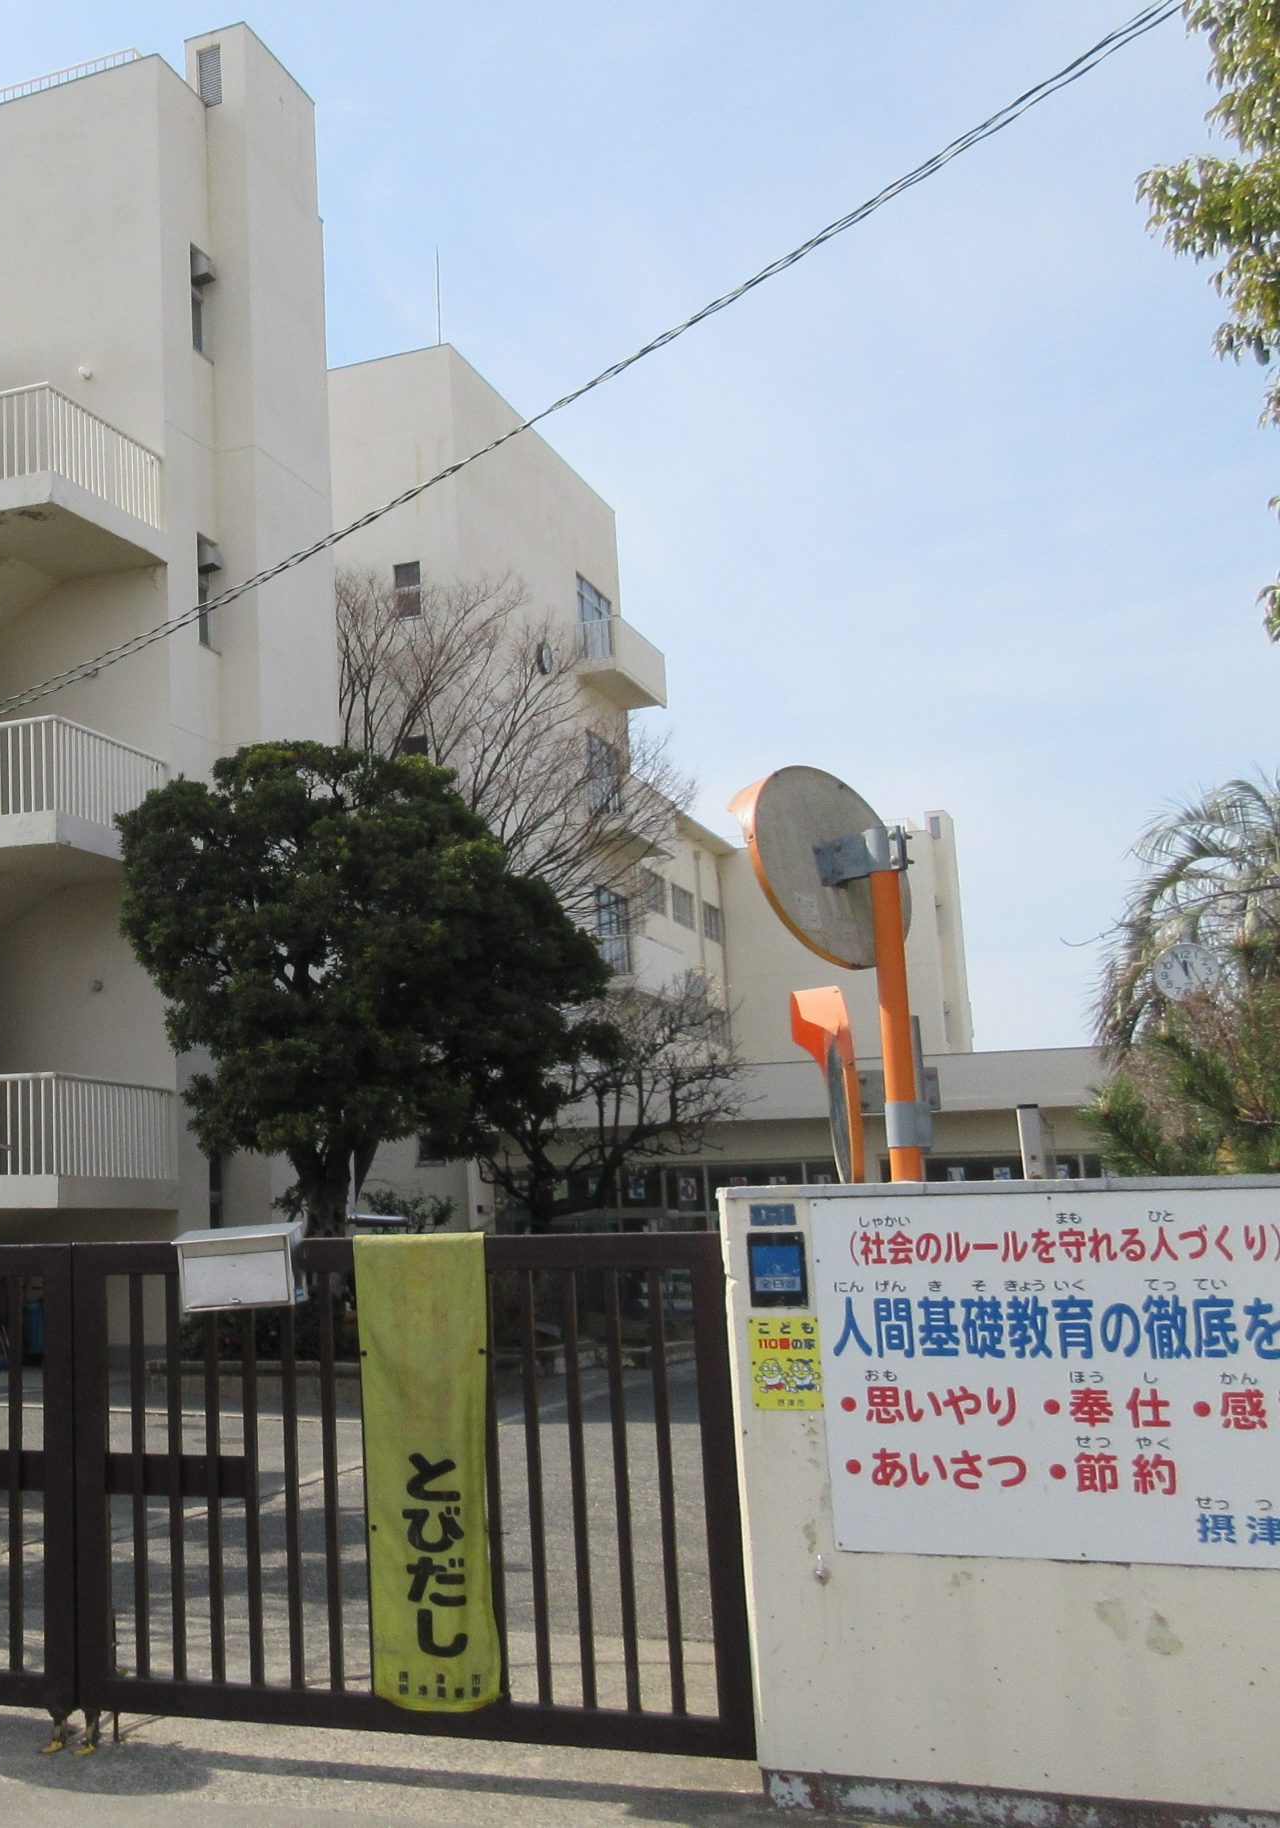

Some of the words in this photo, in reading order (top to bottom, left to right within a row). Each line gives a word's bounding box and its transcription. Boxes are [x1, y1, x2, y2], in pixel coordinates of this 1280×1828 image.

[858, 1215, 911, 1227] しゃかい
[1056, 1212, 1082, 1225] まも
[1147, 1210, 1175, 1223] ひと
[833, 1281, 864, 1294] にん
[875, 1280, 907, 1293] げん
[928, 1280, 942, 1293] き
[971, 1280, 986, 1292] そ
[1003, 1280, 1045, 1293] きょう
[1053, 1279, 1085, 1292] いく
[1193, 1278, 1227, 1291] てい
[758, 1322, 815, 1335] こども
[833, 1295, 1280, 1360] 人間基礎教育の徹底を
[864, 1370, 898, 1382] おも
[1069, 1371, 1104, 1384] ほう
[1143, 1371, 1158, 1384] し
[1220, 1372, 1258, 1386] かん
[1075, 1435, 1111, 1448] せつ
[1136, 1436, 1171, 1450] やく
[401, 1452, 469, 1658] とびだし
